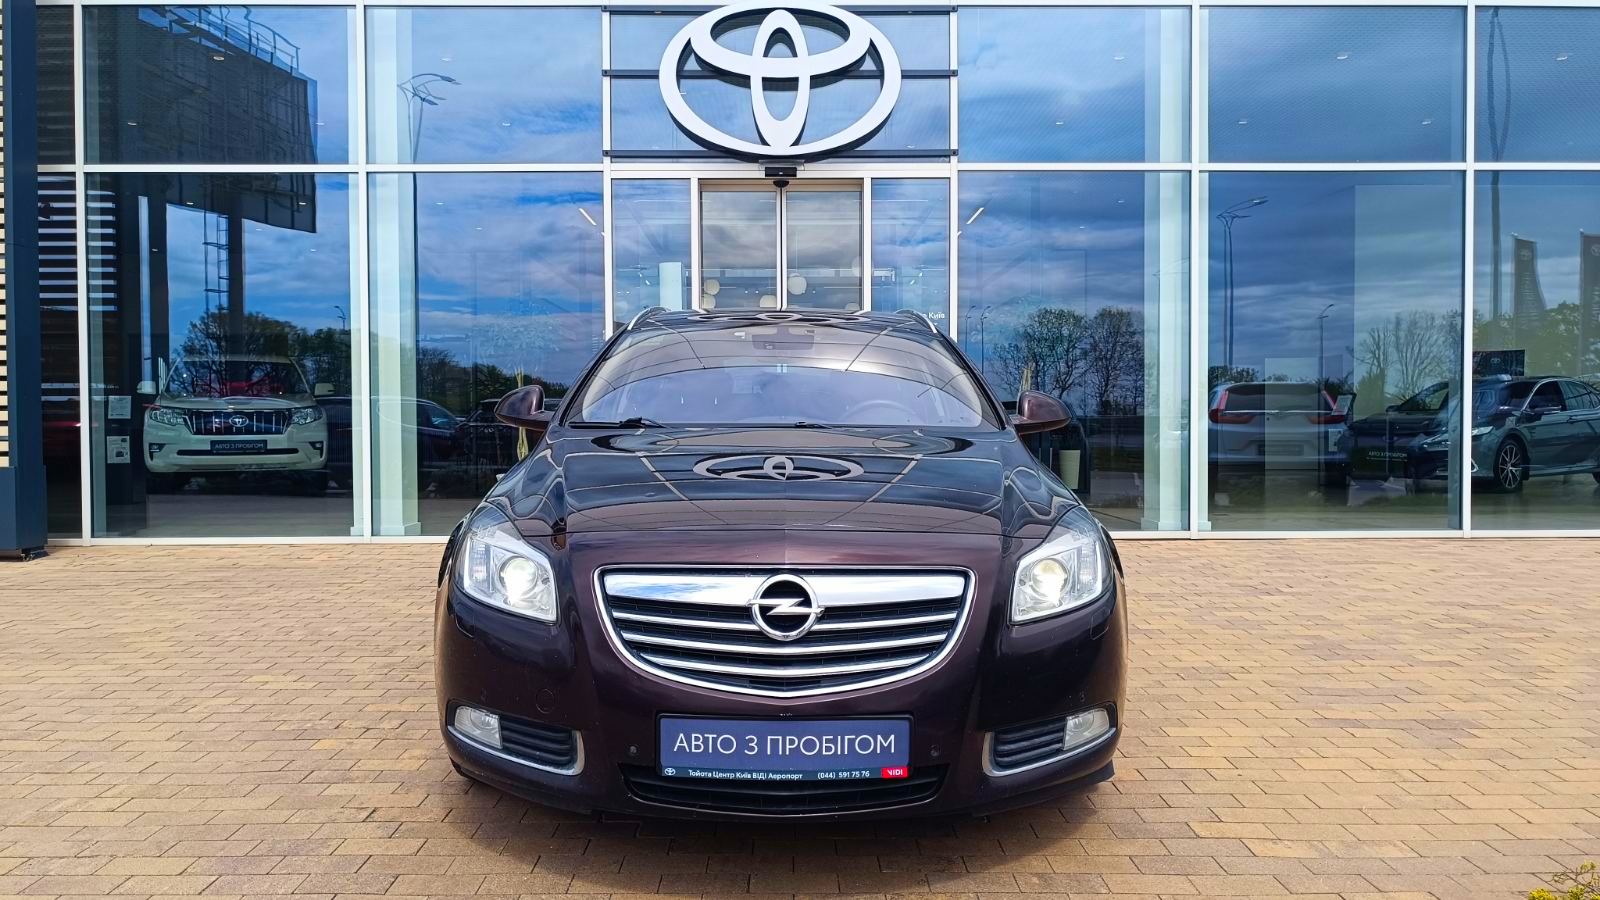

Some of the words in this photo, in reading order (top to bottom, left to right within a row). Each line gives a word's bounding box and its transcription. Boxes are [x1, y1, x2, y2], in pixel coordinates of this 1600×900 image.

[673, 733, 737, 754] АВТО
[744, 735, 758, 755] З
[767, 734, 895, 755] ПРОБІГОМ
[688, 769, 712, 777] Тойота
[712, 770, 735, 779] Центр
[736, 771, 752, 779] Київ
[768, 773, 803, 781] Аеропорт
[817, 771, 836, 780] (044)
